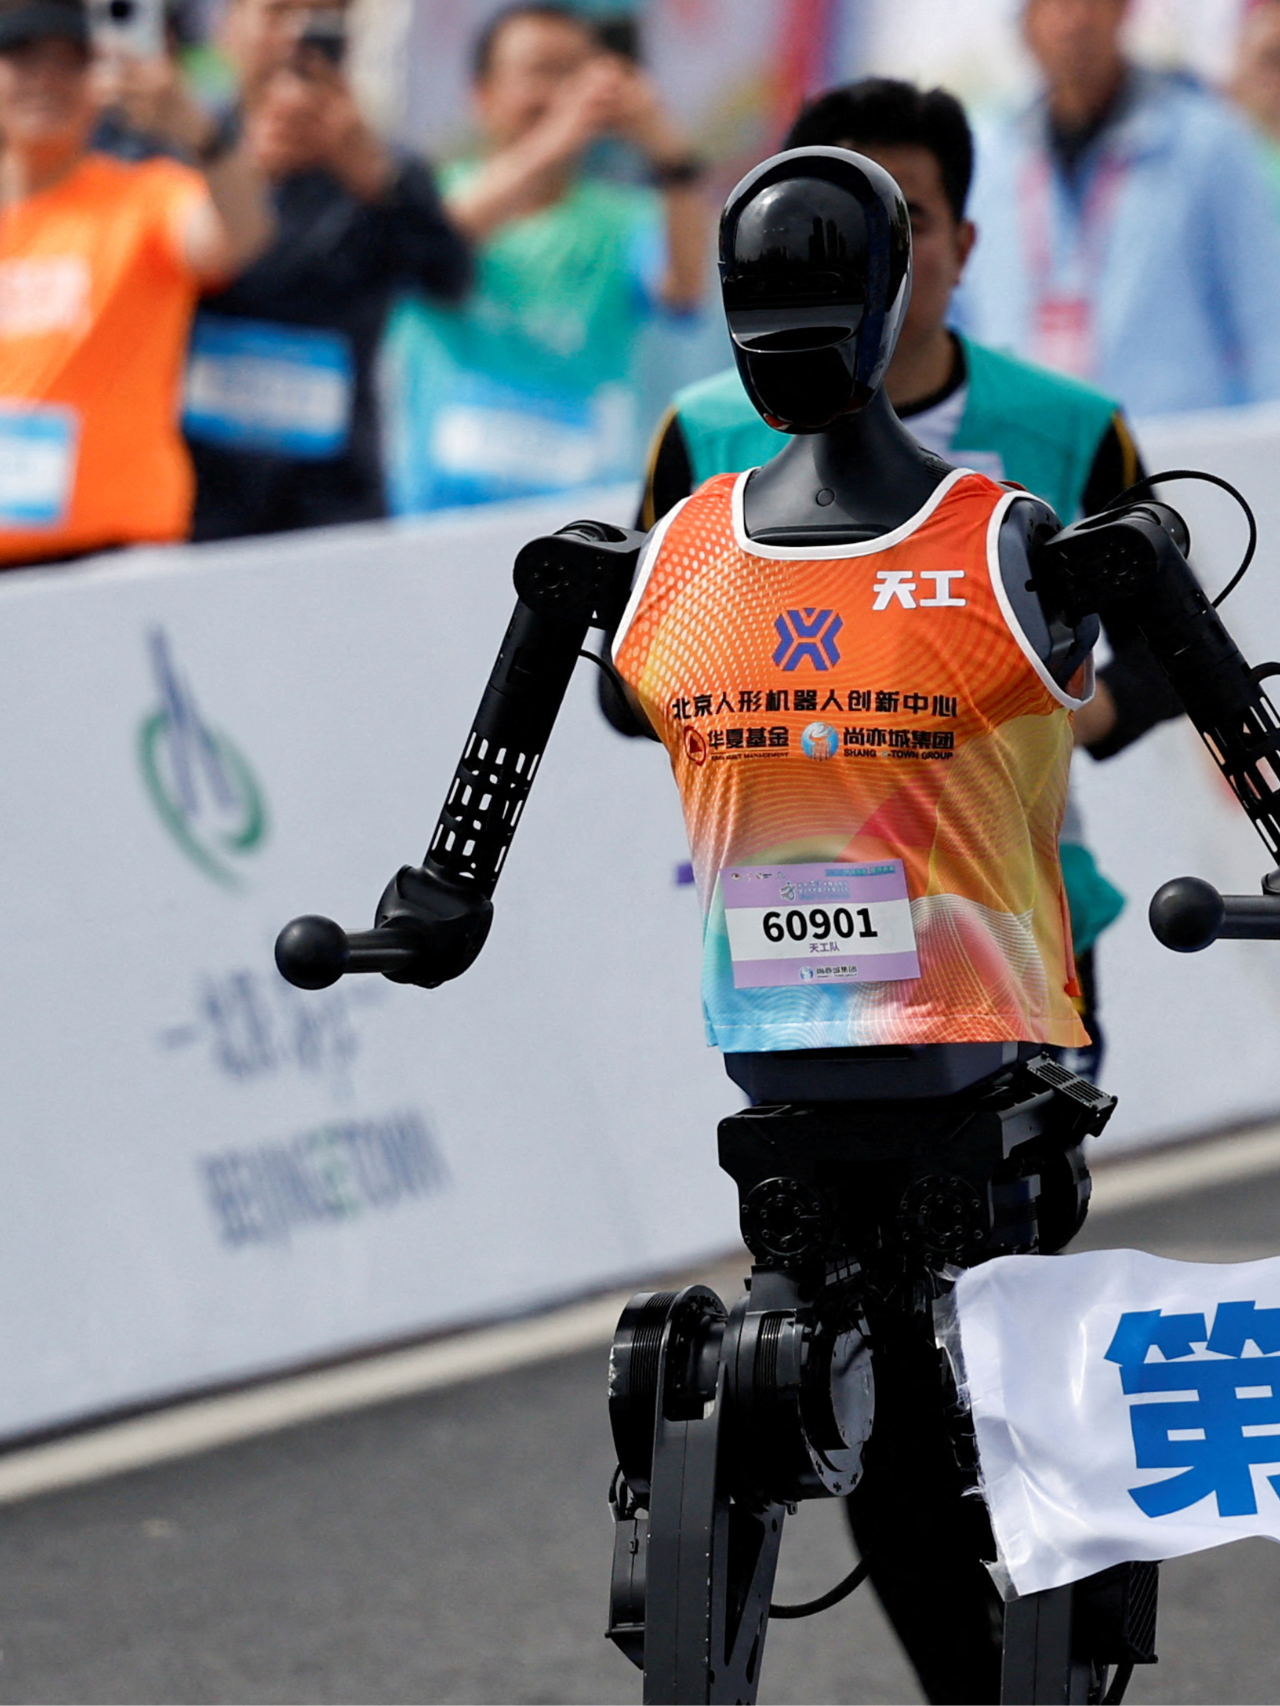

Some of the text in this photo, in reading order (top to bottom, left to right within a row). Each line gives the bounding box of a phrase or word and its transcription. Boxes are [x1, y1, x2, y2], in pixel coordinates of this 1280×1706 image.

[872, 569, 967, 611] 天工
[672, 689, 957, 720] 北京人形机器人创新中心
[708, 726, 789, 750] 华夏基金
[843, 727, 955, 750] 尚亦城集团
[844, 749, 877, 758] SHANG
[921, 751, 953, 761] GROUP
[763, 907, 878, 943] 60901
[809, 941, 840, 953] 天工队
